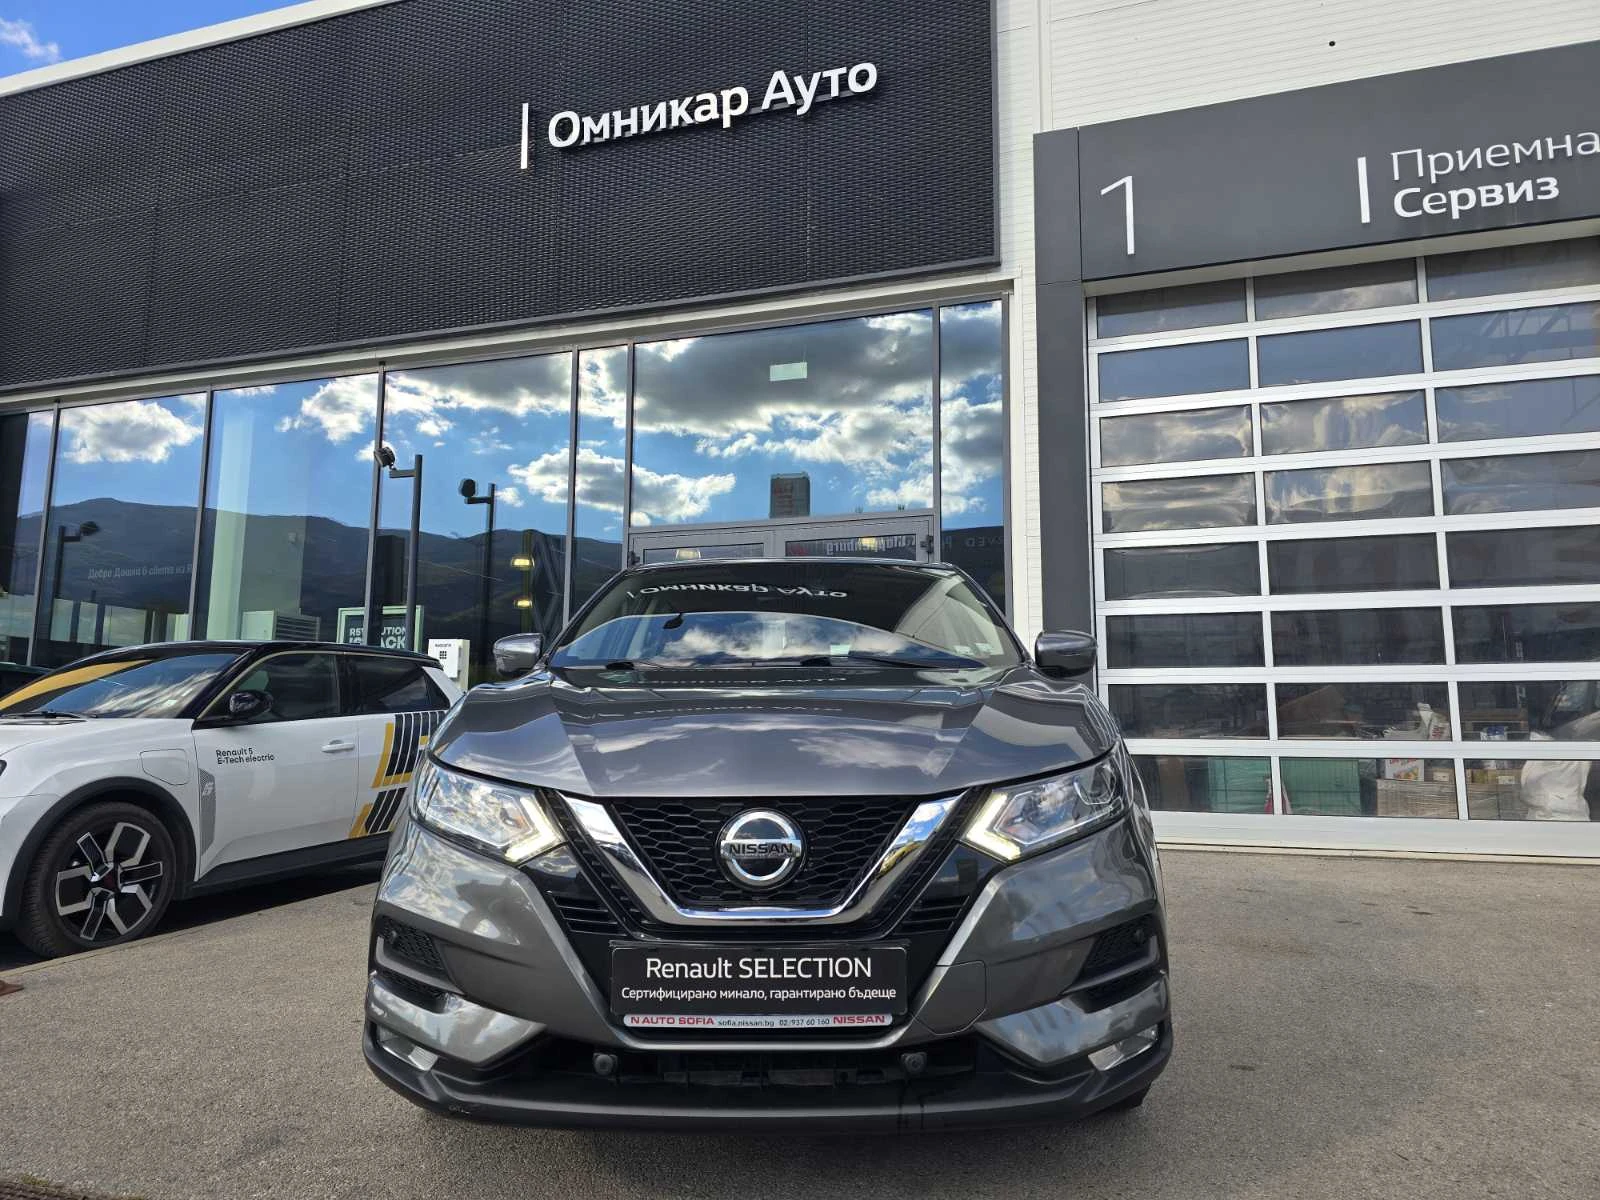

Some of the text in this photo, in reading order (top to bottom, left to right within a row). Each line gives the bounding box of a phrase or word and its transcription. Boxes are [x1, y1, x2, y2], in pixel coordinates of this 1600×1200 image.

[548, 62, 878, 148] Омникар Ауто
[1390, 131, 1600, 184] Приемна
[1393, 174, 1560, 219] Сервиз
[1100, 175, 1135, 255] 1
[216, 747, 253, 758] Renault 5
[217, 753, 275, 765] E-Tech electric
[729, 843, 793, 855] NISSAN
[646, 957, 872, 979] Renault SELECTION
[621, 986, 897, 1001] Сертифицирано минало, гарантирано бъдеще
[630, 1017, 640, 1025] N
[641, 1017, 675, 1025] AUTO
[678, 1017, 715, 1025] SOFIA
[717, 1018, 775, 1028] sofia.nissan.bg
[832, 1015, 885, 1024] NISSAN
